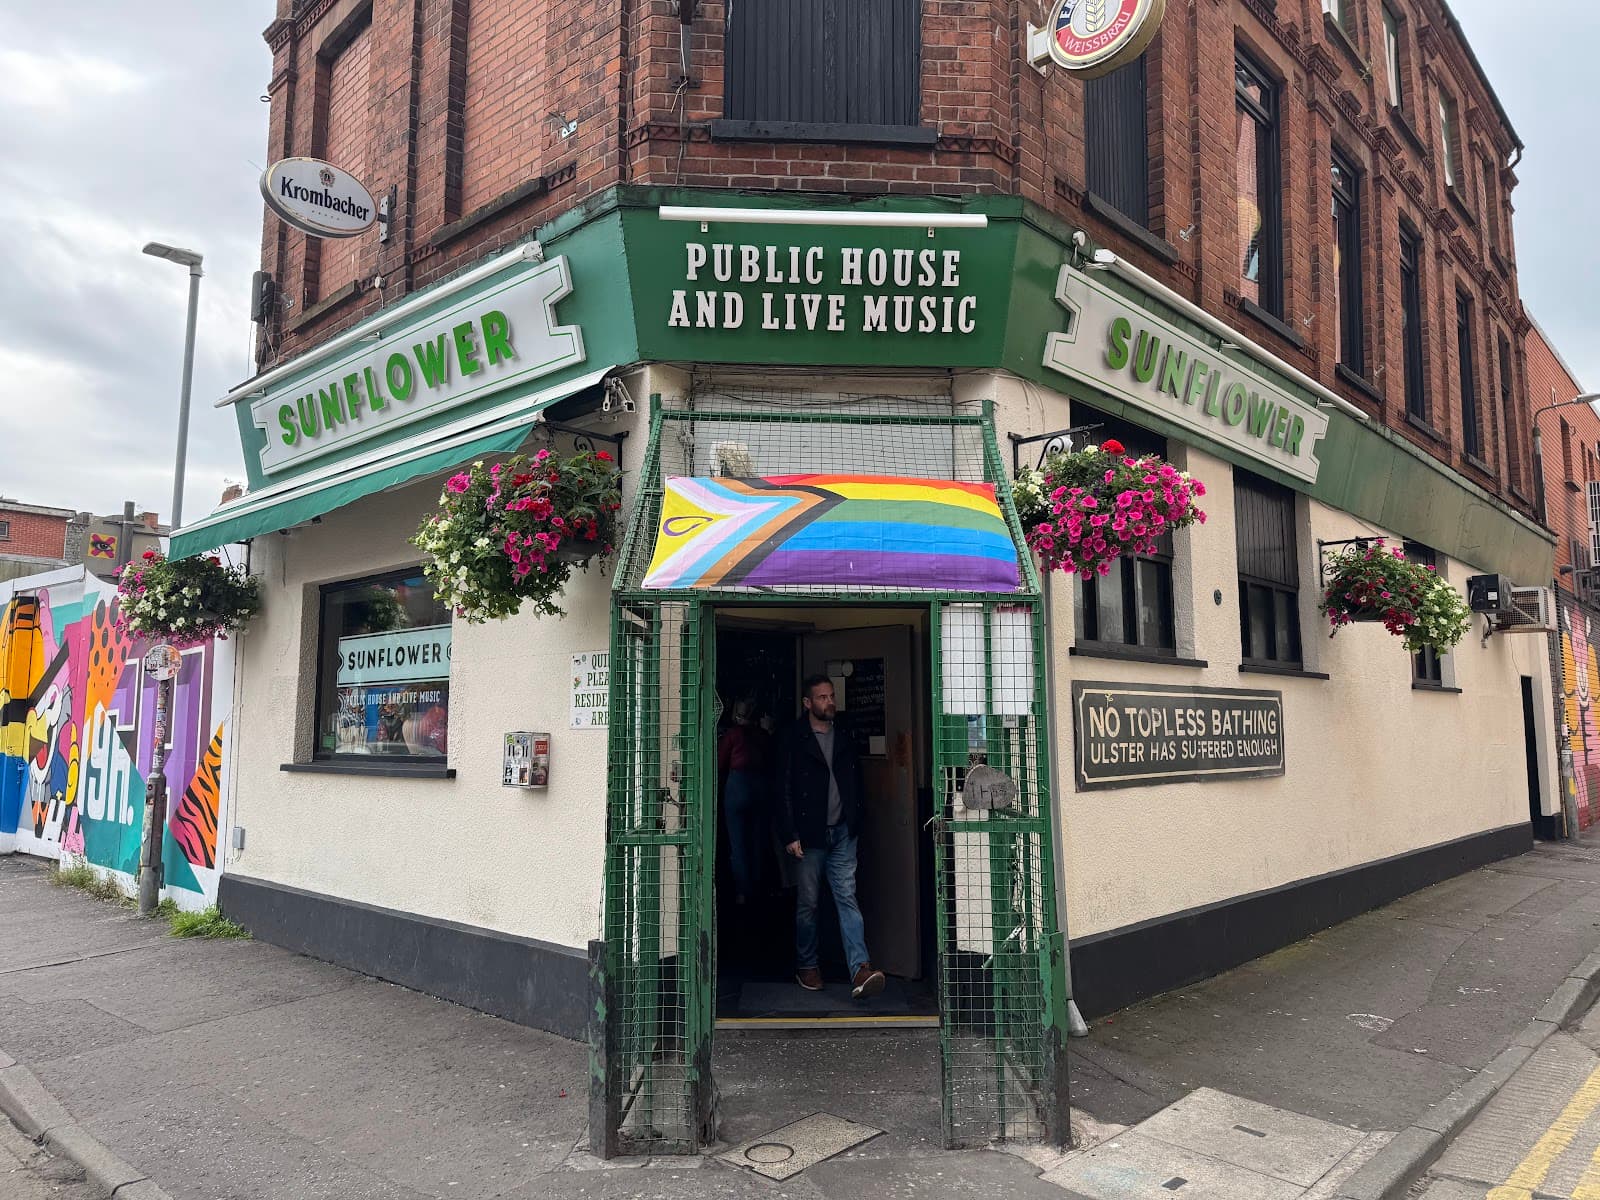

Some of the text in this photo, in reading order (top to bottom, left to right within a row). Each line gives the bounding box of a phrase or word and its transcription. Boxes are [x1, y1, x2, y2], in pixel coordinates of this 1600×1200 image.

[281, 176, 370, 221] Krombacher
[686, 243, 961, 287] PUBLIC HOUSE
[667, 290, 977, 333] AND LIVE MUSIC
[277, 309, 515, 446] SUNFLOWER
[1106, 317, 1306, 457] SUNFLOWER
[347, 642, 441, 671] SUNFLOWER
[591, 653, 610, 670] QUI
[367, 693, 386, 705] HOUSE
[402, 691, 417, 704] LIVE
[419, 690, 441, 703] MUSIC
[1089, 706, 1277, 738] NO TOPLESS BATHING
[1091, 739, 1278, 764] ULSTER HAS SUFFERED ENOUGH
